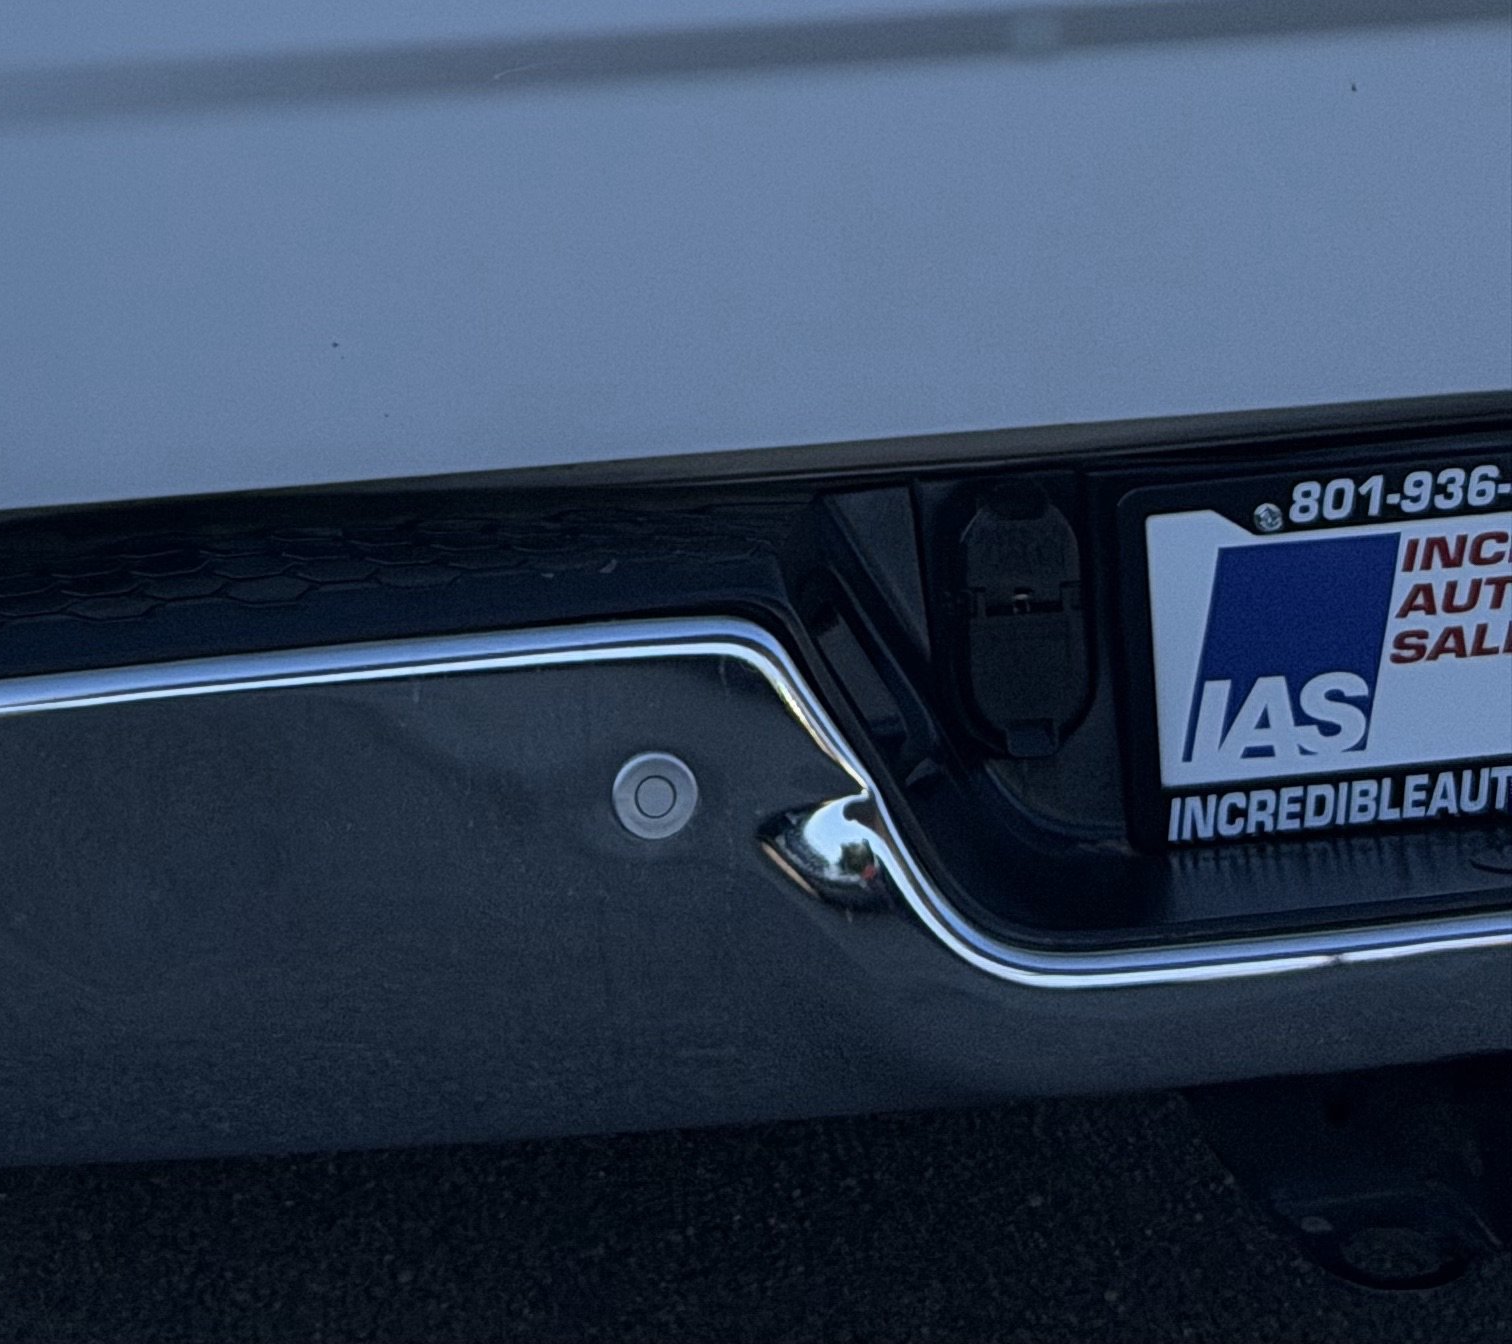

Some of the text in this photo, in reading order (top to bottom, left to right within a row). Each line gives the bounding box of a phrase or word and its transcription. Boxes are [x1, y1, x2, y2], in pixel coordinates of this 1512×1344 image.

[1289, 465, 1512, 523] 801-936-
[1401, 531, 1512, 572] INC
[1395, 576, 1512, 618] AUT
[1190, 671, 1370, 763] IAS
[1168, 765, 1512, 842] INCREDIBLEAUT
